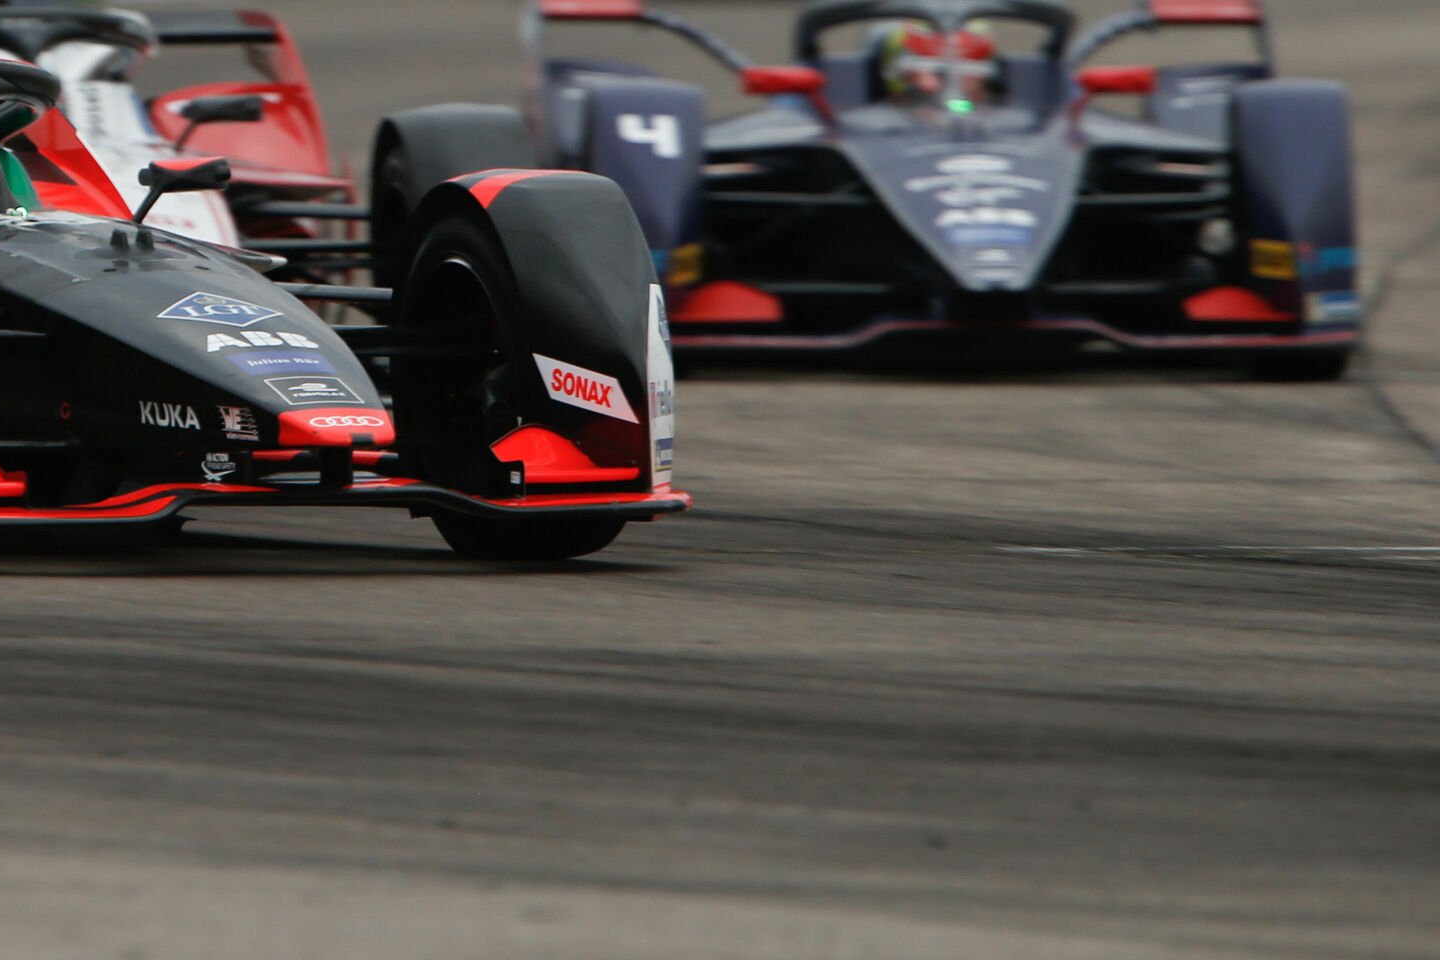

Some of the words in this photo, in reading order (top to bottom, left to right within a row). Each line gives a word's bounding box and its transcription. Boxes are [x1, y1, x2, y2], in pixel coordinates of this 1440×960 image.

[617, 114, 681, 158] 4
[181, 304, 260, 318] LGT
[207, 330, 319, 353] ABB
[550, 368, 613, 409] SONAX
[139, 400, 201, 430] KUKA
